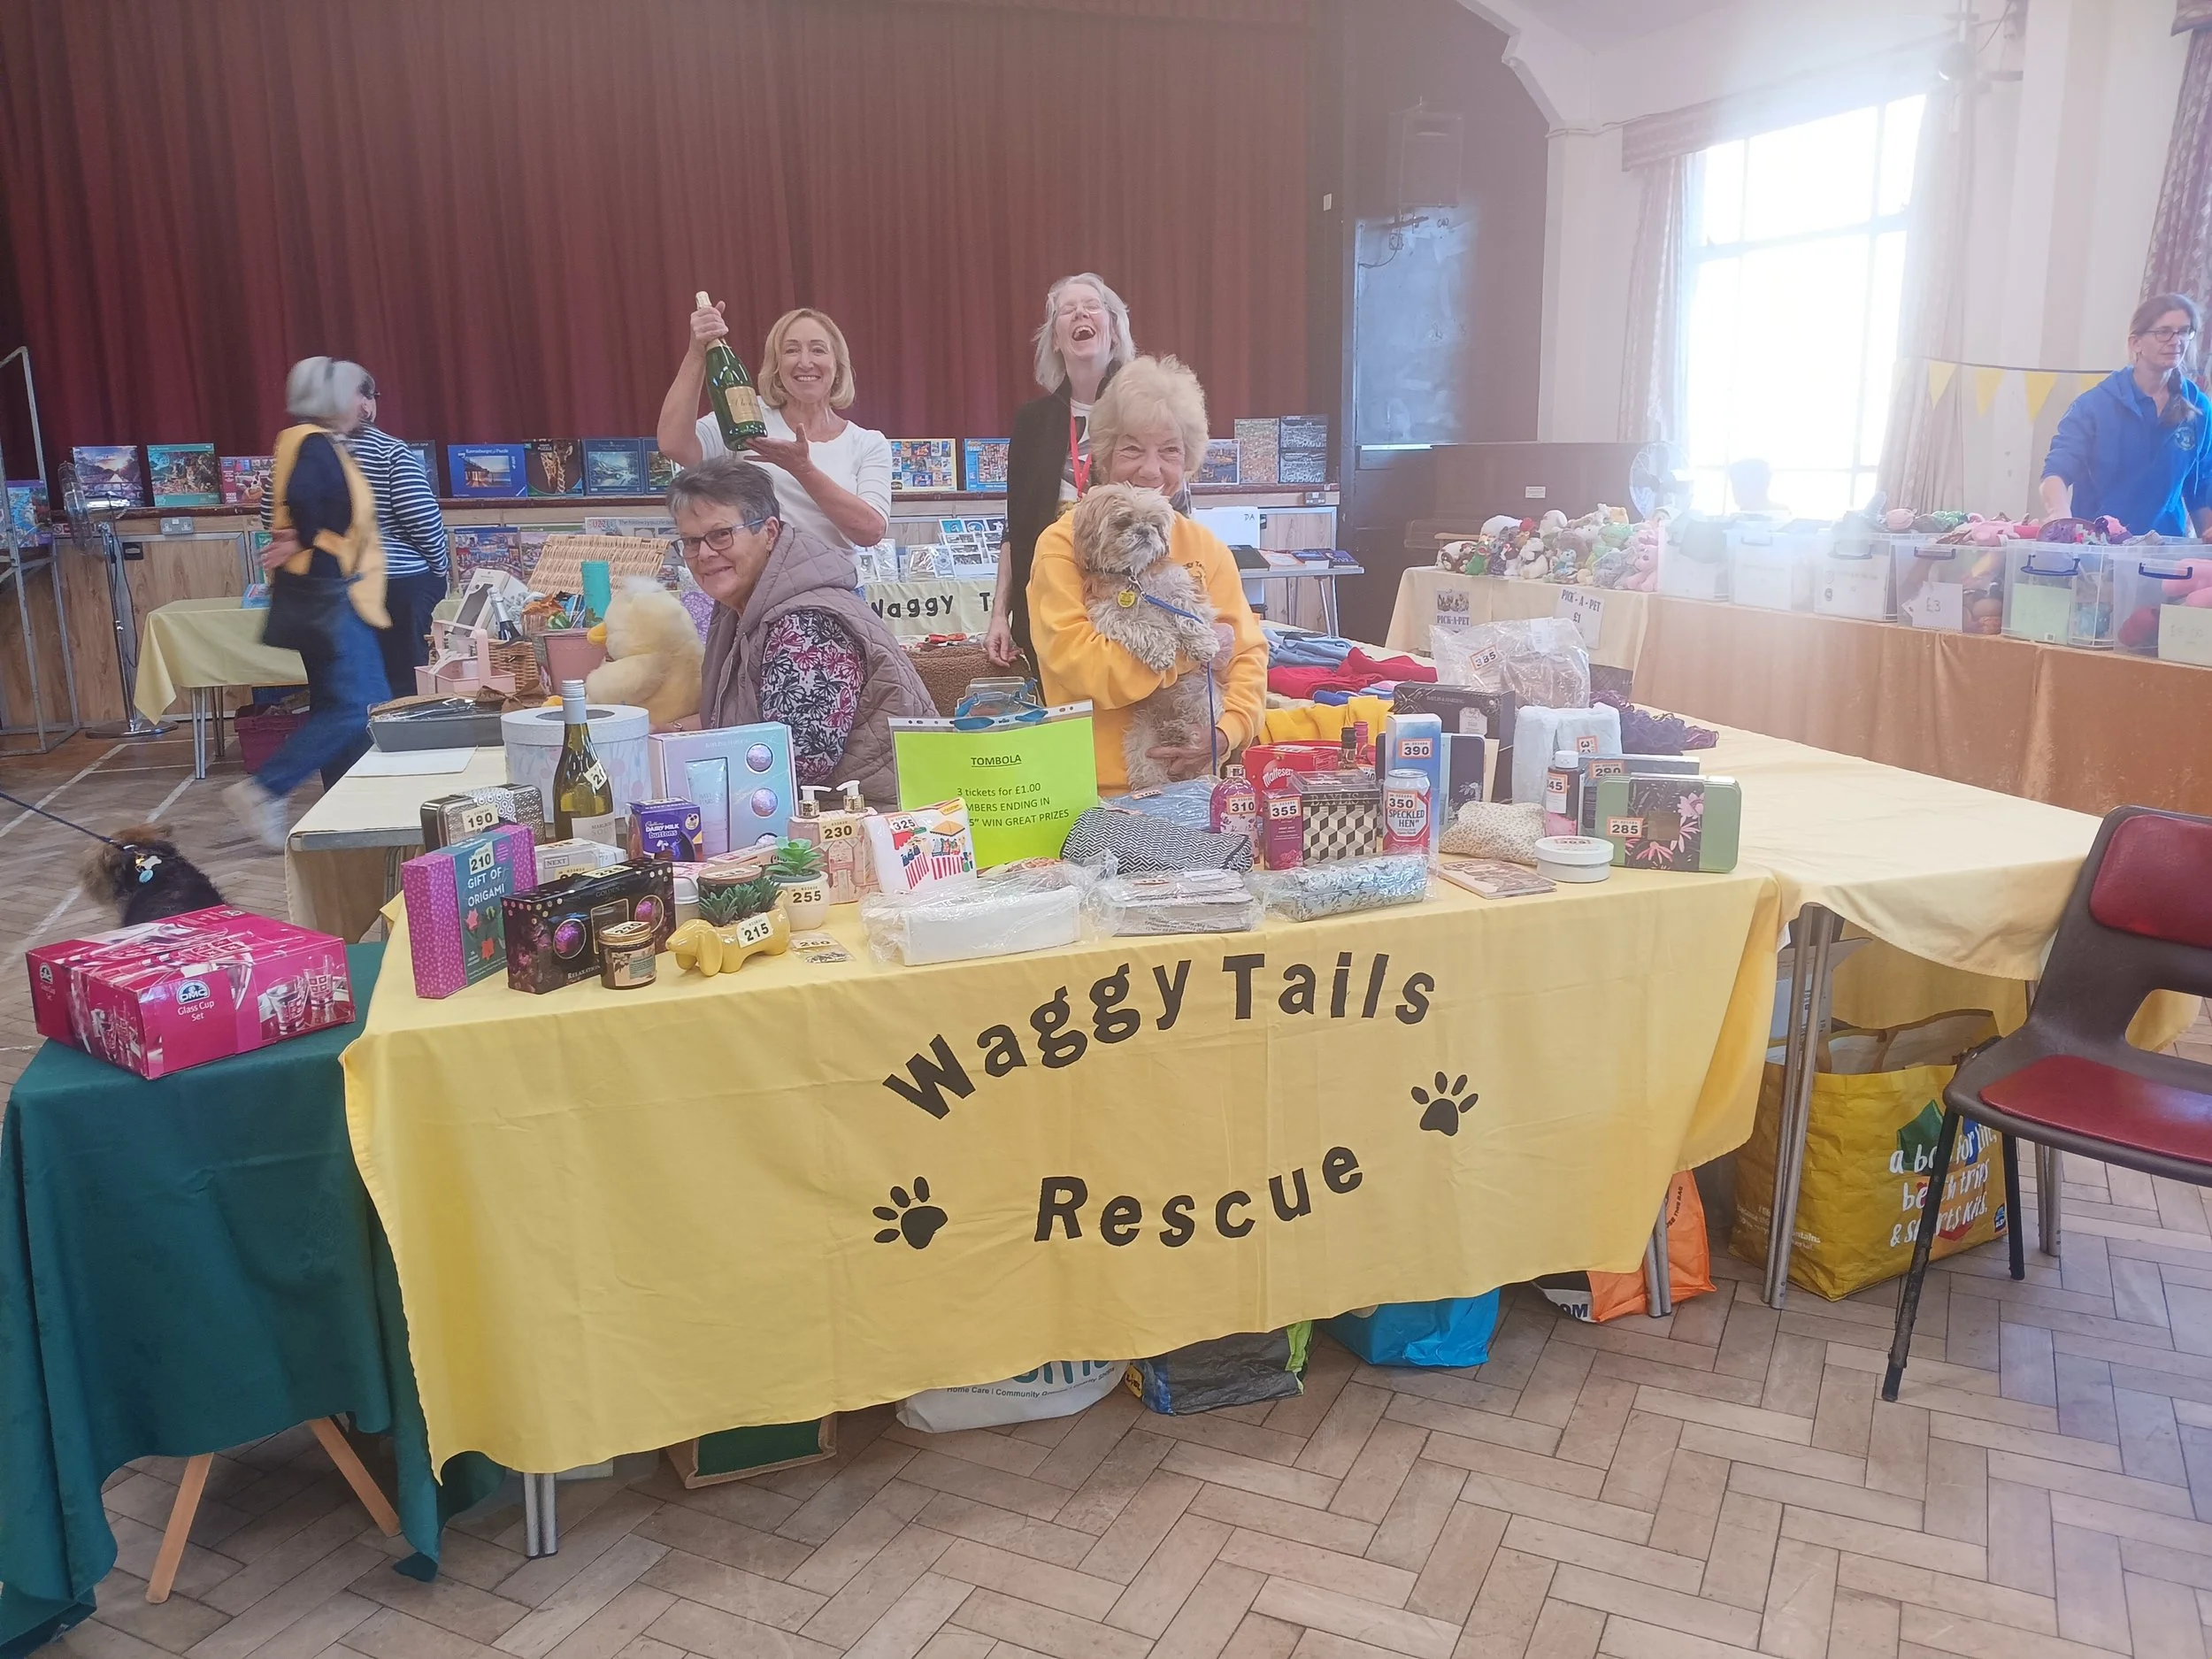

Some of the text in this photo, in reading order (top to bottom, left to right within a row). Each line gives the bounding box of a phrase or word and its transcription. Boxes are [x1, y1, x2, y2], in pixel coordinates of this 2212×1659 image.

[1561, 589, 1574, 602] PICK
[1589, 599, 1601, 612] PET
[1475, 651, 1496, 667] 385
[1404, 746, 1429, 756] 390
[971, 755, 1022, 766] TOMBOLA
[965, 787, 996, 797] tickets
[998, 787, 1012, 795] for
[1015, 782, 1041, 795] £1.00
[1001, 799, 1038, 811] ENDING
[1041, 797, 1050, 806] IN
[1232, 802, 1255, 812] 310
[1389, 798, 1414, 809] 350
[1272, 805, 1297, 818] 355
[1388, 809, 1425, 819] SPECKLED
[468, 812, 493, 828] 190
[893, 819, 915, 831] 325
[982, 818, 1002, 827] WIN
[1005, 815, 1037, 827] GREAT
[1040, 810, 1070, 821] PRIZES
[649, 830, 678, 839] buttons
[825, 826, 852, 839] 230
[1612, 825, 1639, 834] 285
[471, 853, 491, 872] 210
[468, 867, 502, 889] GIFT OF
[468, 883, 505, 907] ORIGAMI
[793, 890, 822, 903] 255
[744, 923, 769, 941] 215
[180, 989, 207, 1002] DMC
[178, 1001, 214, 1016] Glass Cup
[191, 1012, 204, 1021] Set
[883, 951, 1435, 1120] Waggy Tails
[1960, 1159, 1990, 1194] trips
[1033, 1147, 1364, 1248] Rescue
[995, 1389, 1040, 1398] Community
